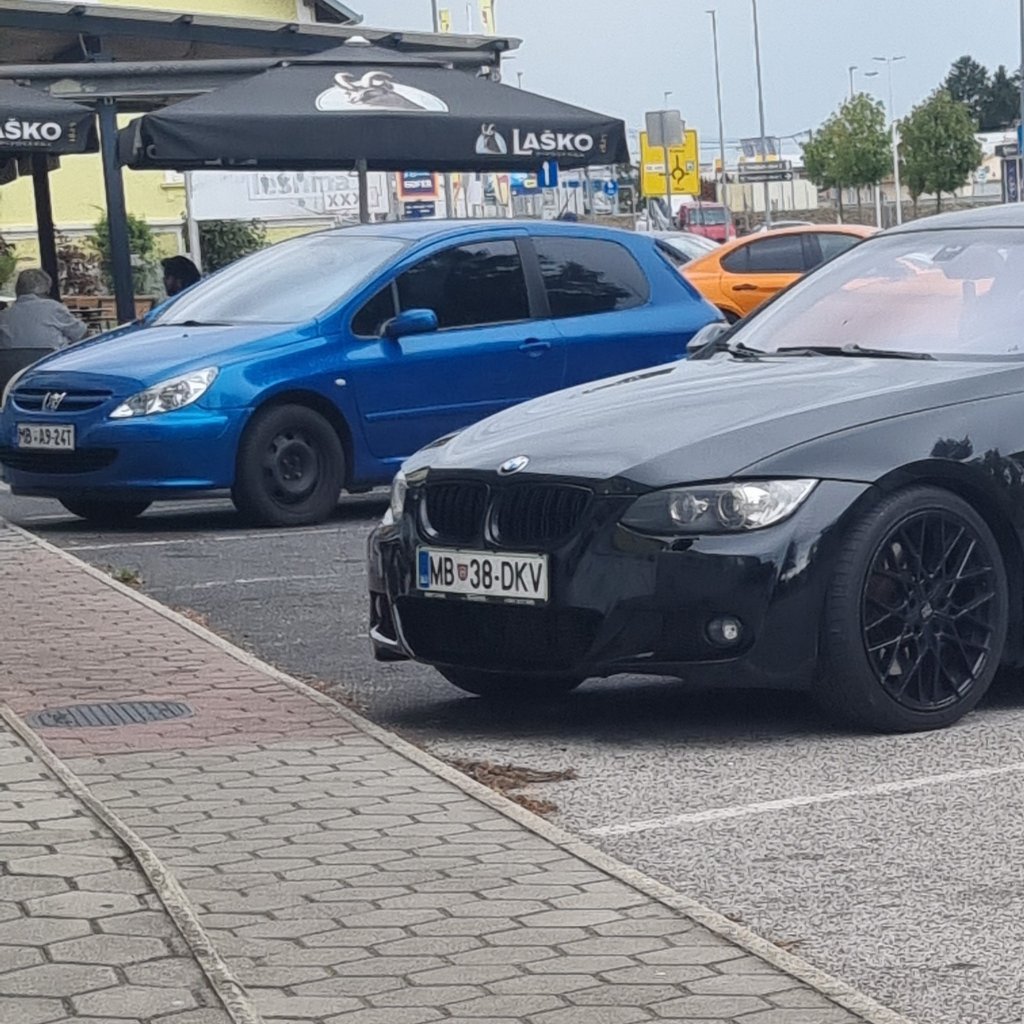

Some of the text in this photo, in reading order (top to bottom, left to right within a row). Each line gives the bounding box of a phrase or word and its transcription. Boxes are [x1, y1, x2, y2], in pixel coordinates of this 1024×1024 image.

[512, 129, 594, 156] LAŠKO
[430, 557, 543, 592] MB 38-DKV
